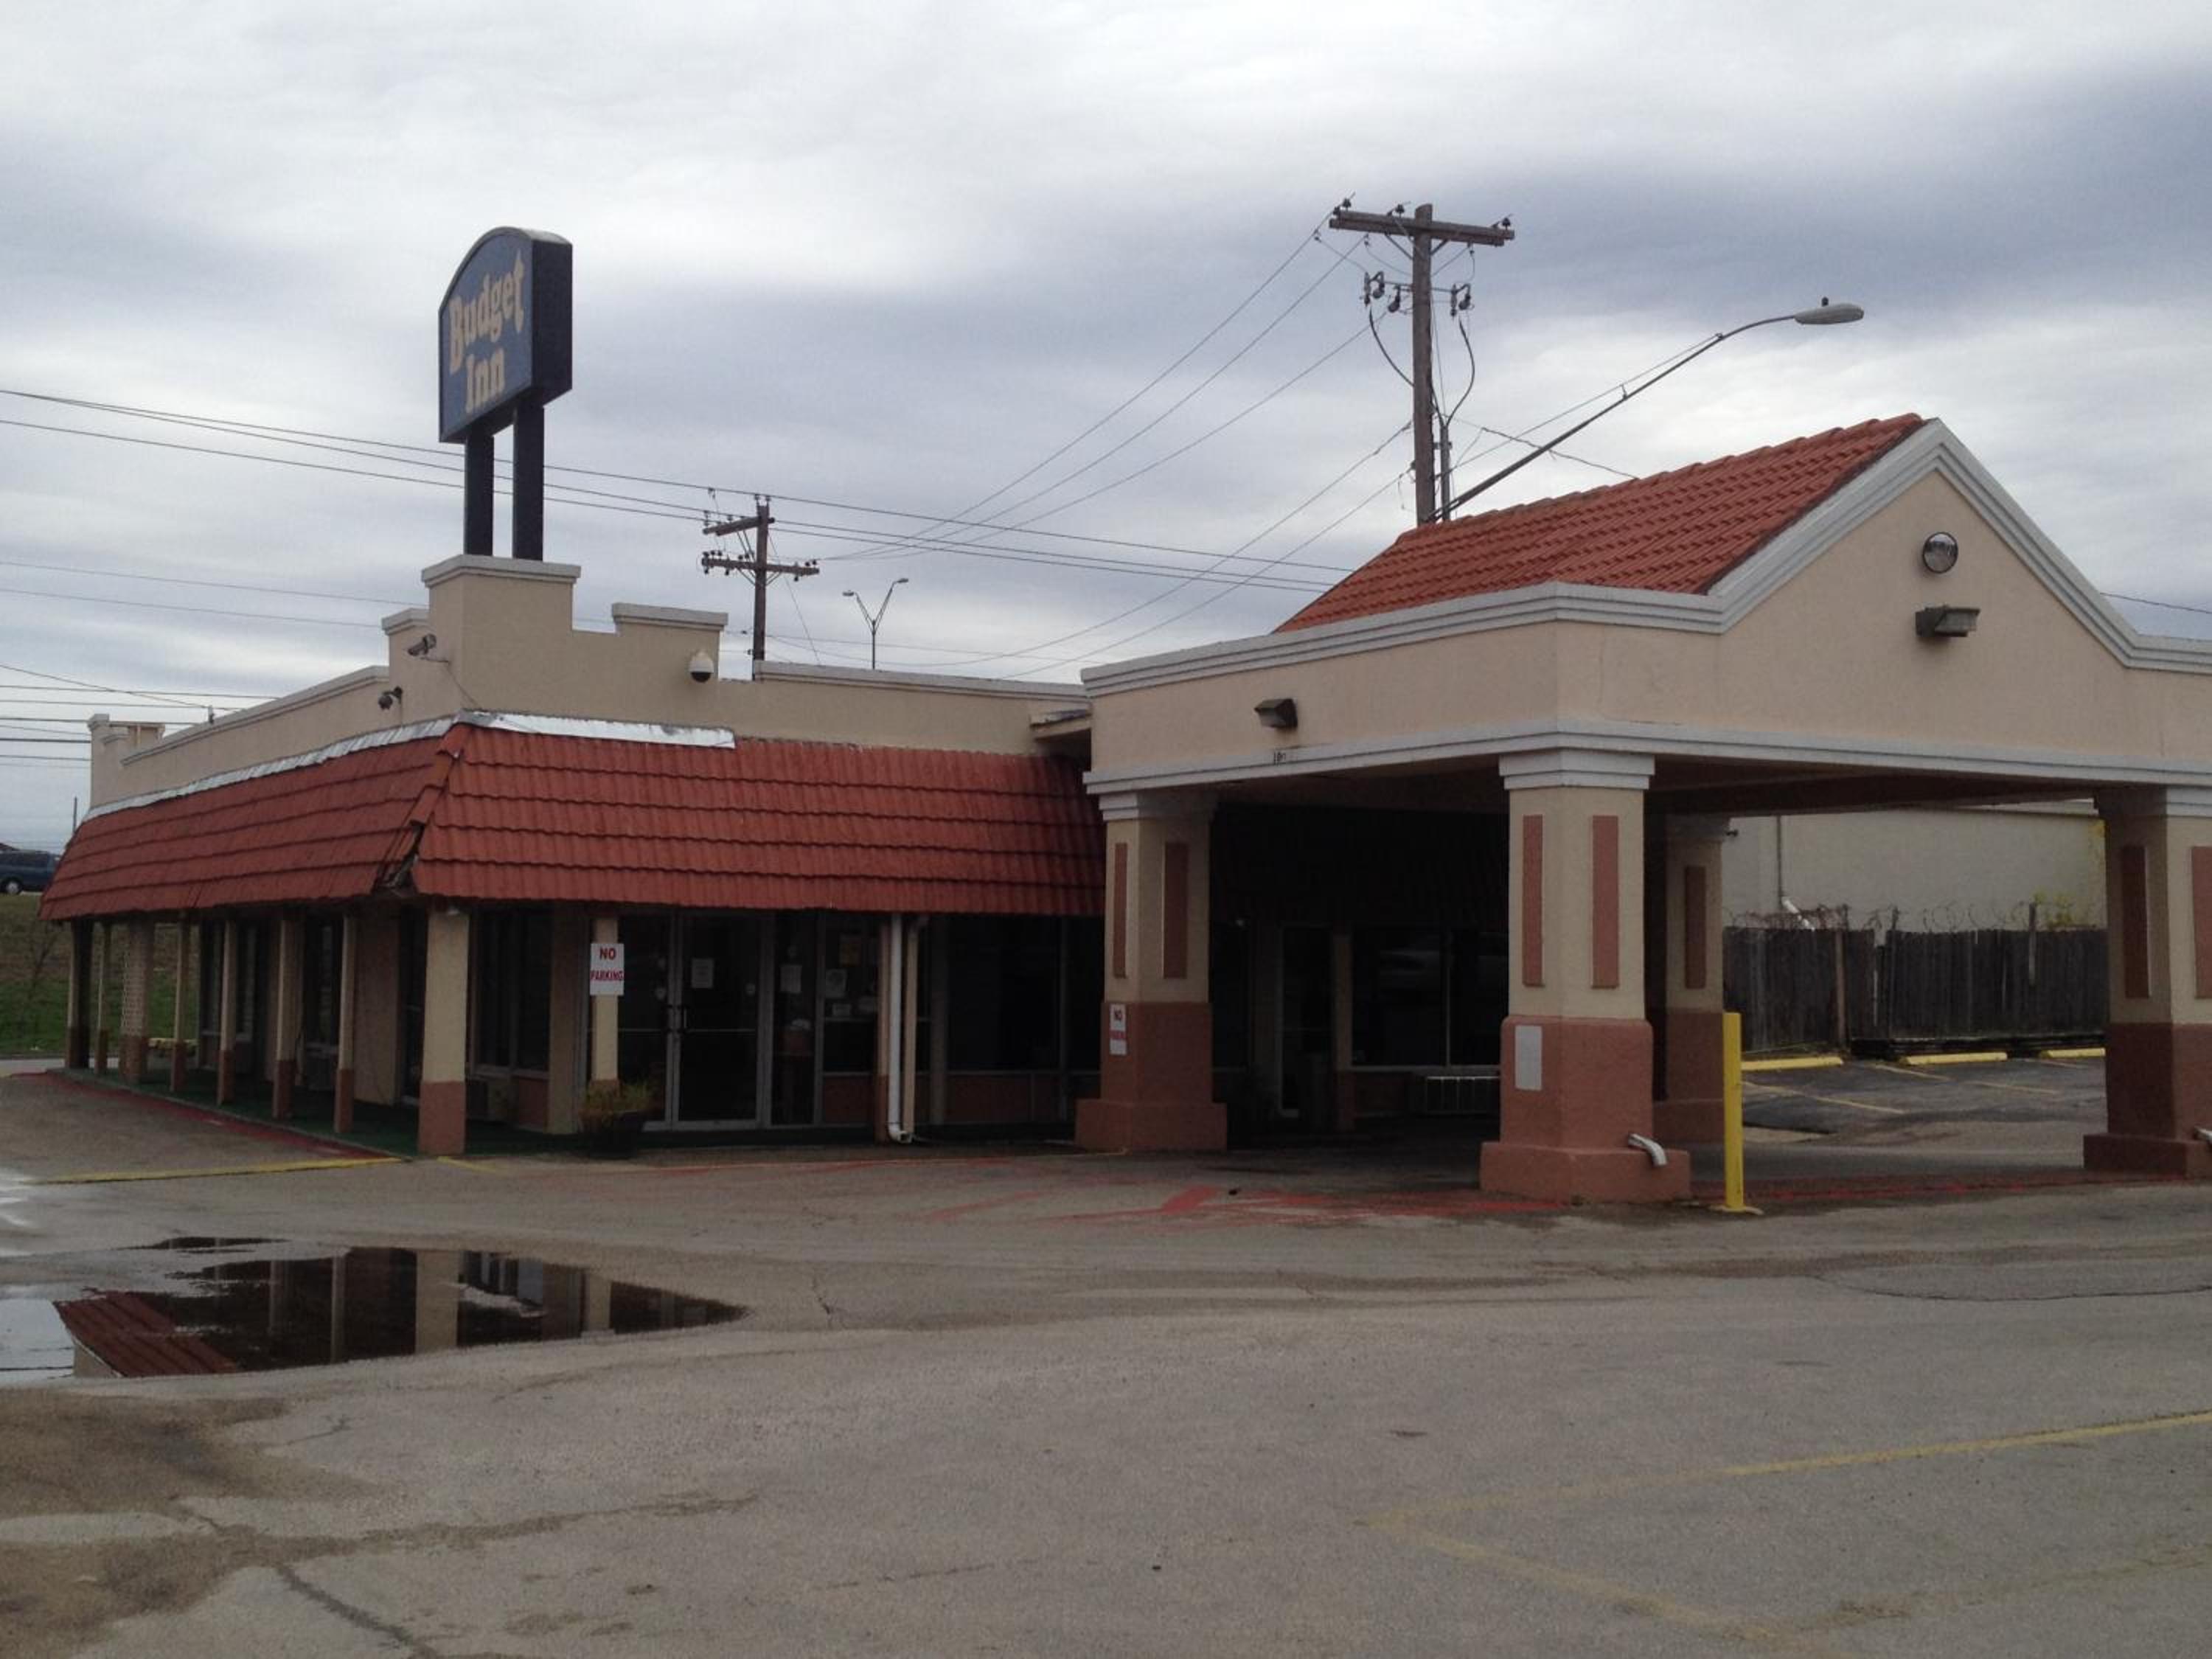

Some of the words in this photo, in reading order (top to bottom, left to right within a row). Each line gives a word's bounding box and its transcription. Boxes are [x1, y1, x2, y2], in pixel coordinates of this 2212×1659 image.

[449, 251, 524, 375] Budget
[466, 347, 505, 414] Inn
[599, 947, 616, 960] NO
[590, 970, 624, 981] PARKING
